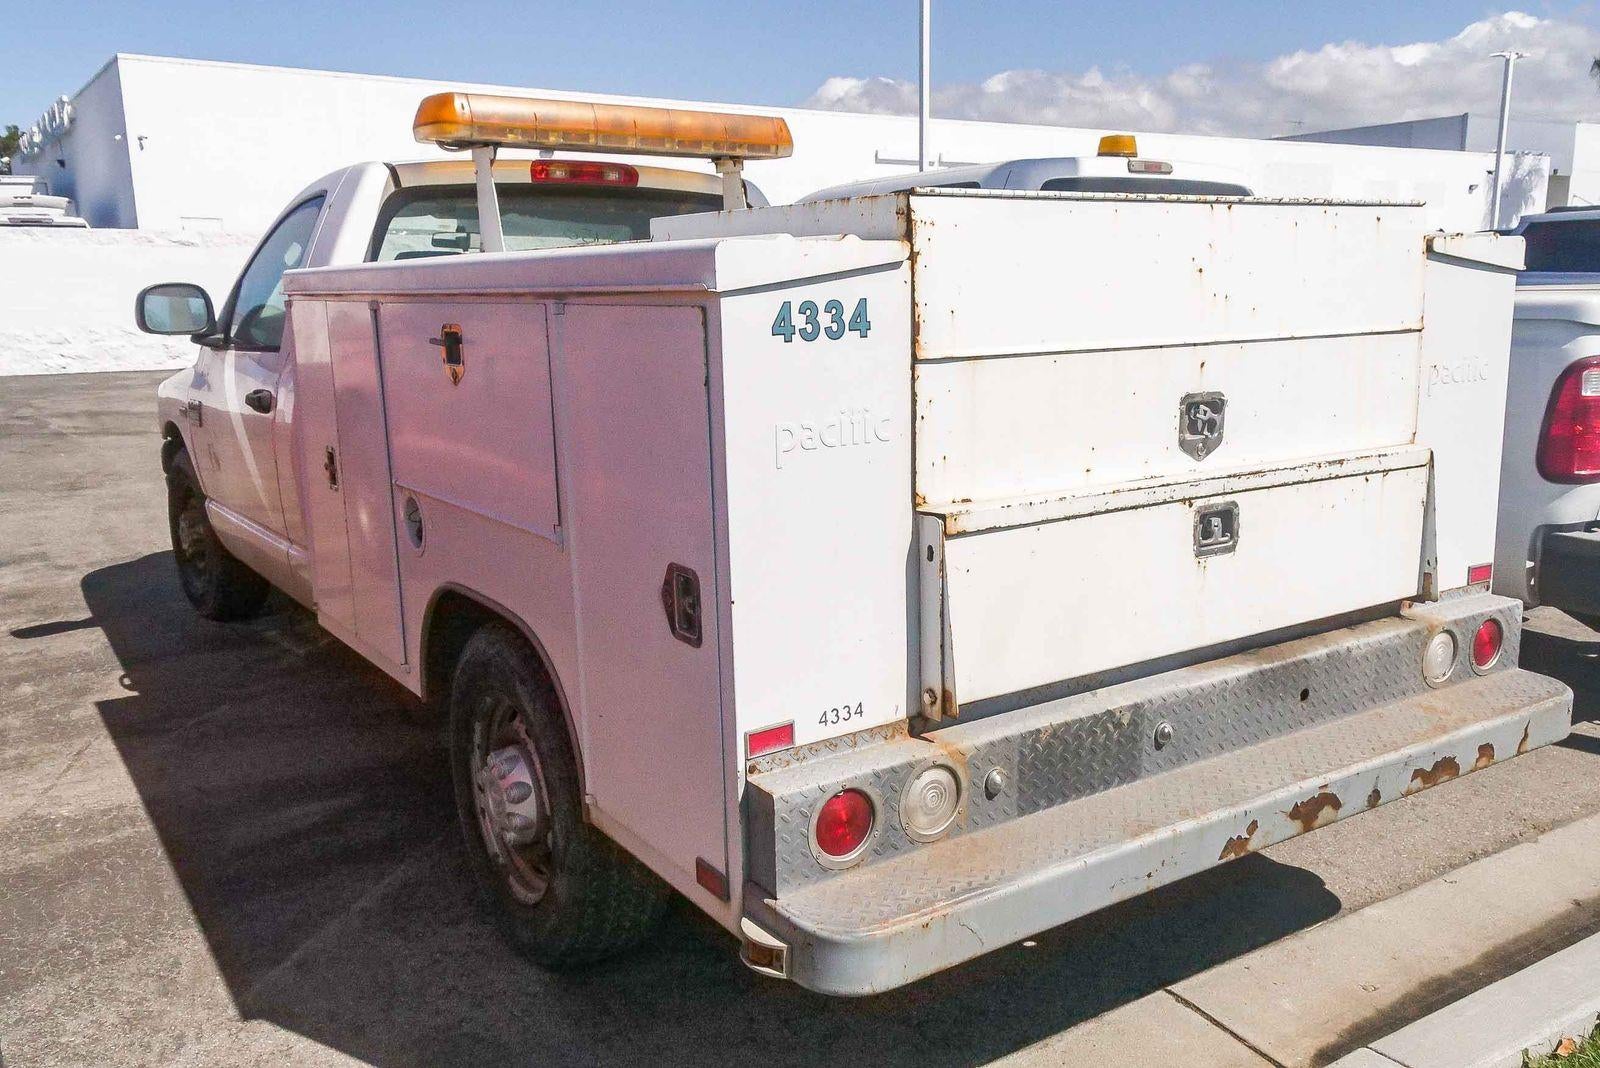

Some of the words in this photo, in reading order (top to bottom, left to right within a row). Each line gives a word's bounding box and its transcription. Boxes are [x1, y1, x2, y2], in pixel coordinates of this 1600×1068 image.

[771, 297, 871, 343] 4334
[775, 406, 892, 470] pacific
[818, 701, 864, 727] 4334
